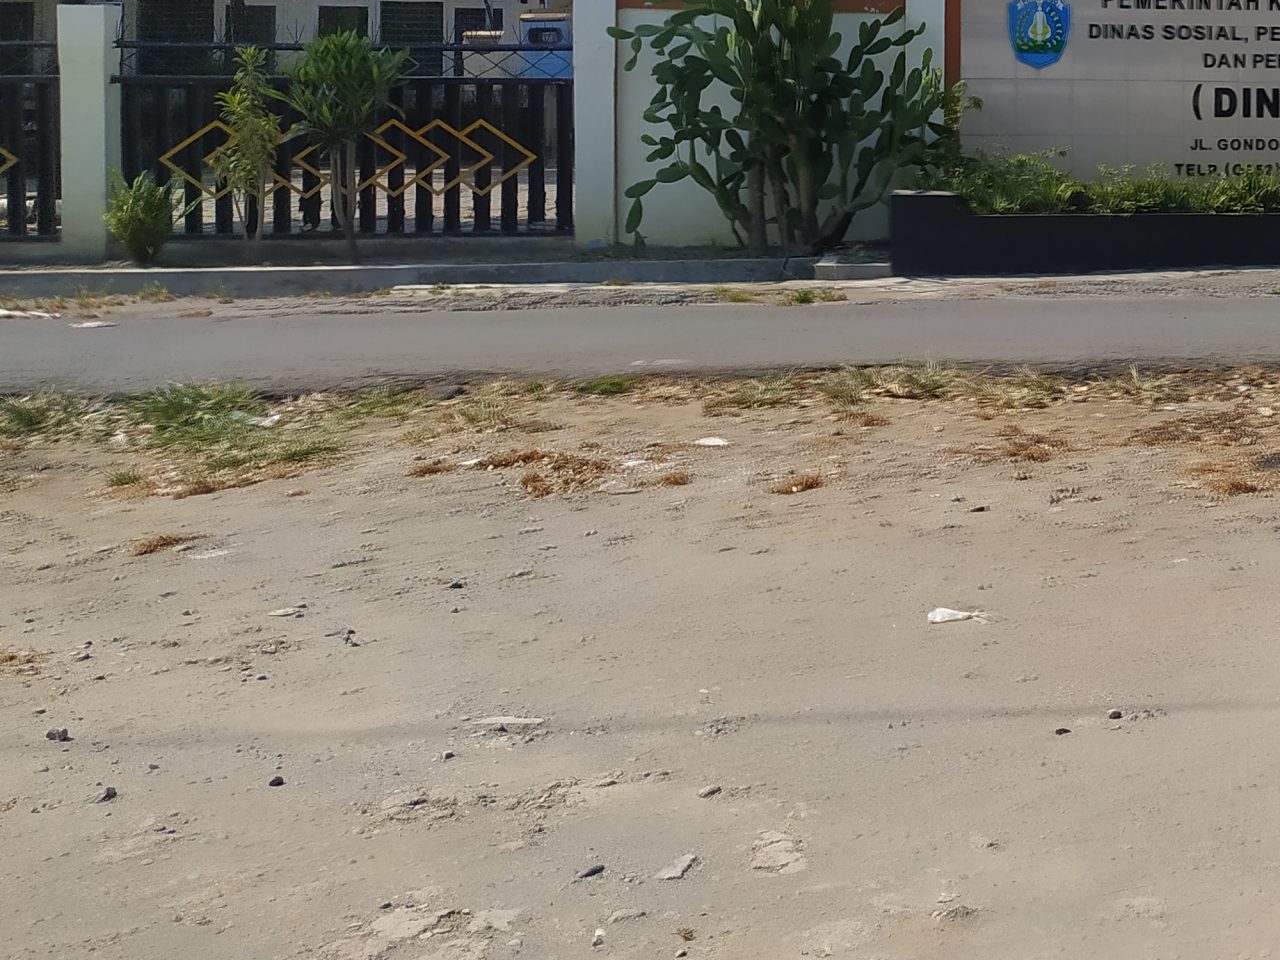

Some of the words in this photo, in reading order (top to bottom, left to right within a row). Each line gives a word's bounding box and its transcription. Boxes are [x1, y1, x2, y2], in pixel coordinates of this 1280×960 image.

[1088, 23, 1155, 40] DINAS
[1161, 24, 1249, 43] SOSIAL,
[1203, 52, 1247, 69] DAN
[1190, 139, 1212, 151] JL.
